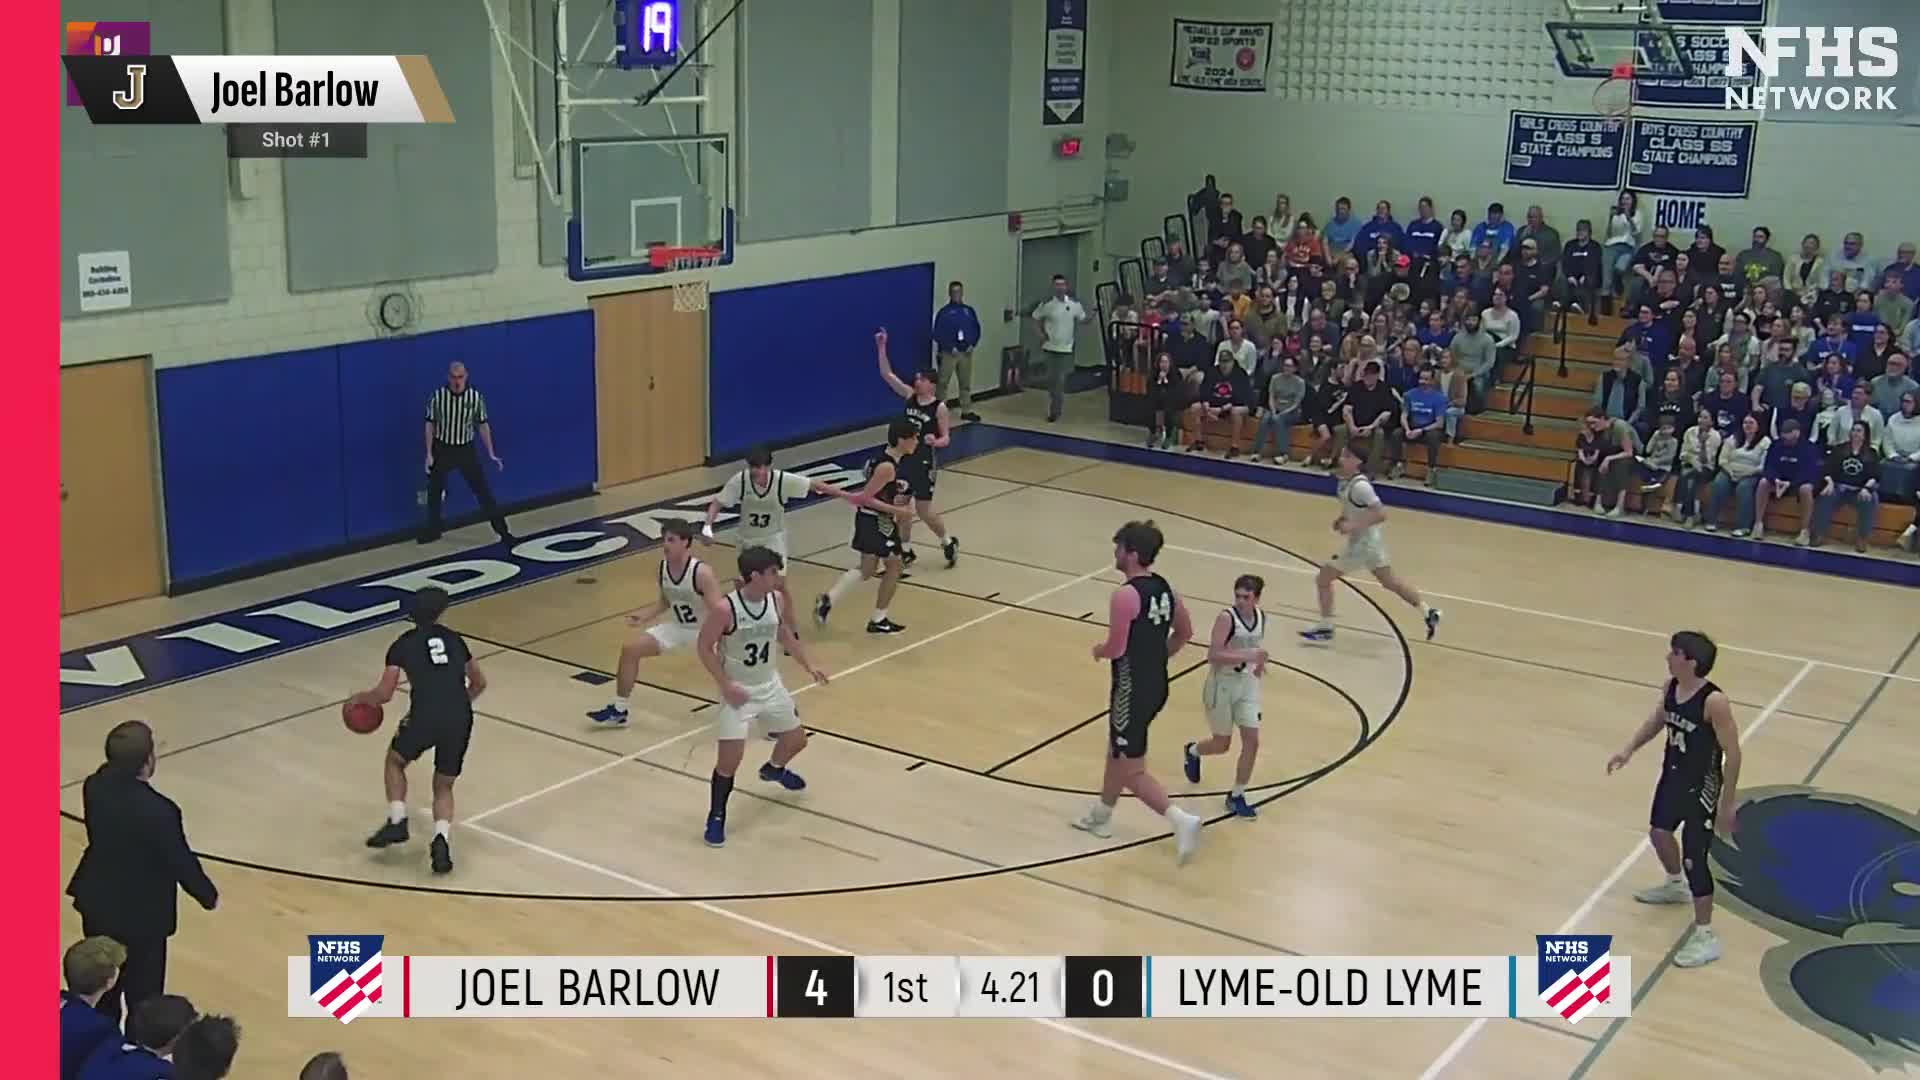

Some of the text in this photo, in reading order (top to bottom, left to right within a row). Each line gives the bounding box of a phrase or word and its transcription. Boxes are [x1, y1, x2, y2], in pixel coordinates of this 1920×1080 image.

[644, 2, 672, 53] 19
[1204, 66, 1234, 76] 2024
[1519, 116, 1621, 133] GIRLS CROSS COUNTRY
[1641, 122, 1745, 140] BOYS CROSS COUNTRY
[1533, 130, 1603, 145] CLASS S
[1649, 136, 1734, 153] CLASS SS
[1519, 142, 1614, 159] STATE CHAMPIONS
[1641, 150, 1738, 166] STATE CHAMPIONS
[1655, 198, 1706, 229] HOME
[749, 513, 770, 528] 33
[672, 604, 697, 624] 12
[1148, 591, 1172, 626] 44
[427, 637, 449, 665] 2
[743, 641, 770, 667] 34
